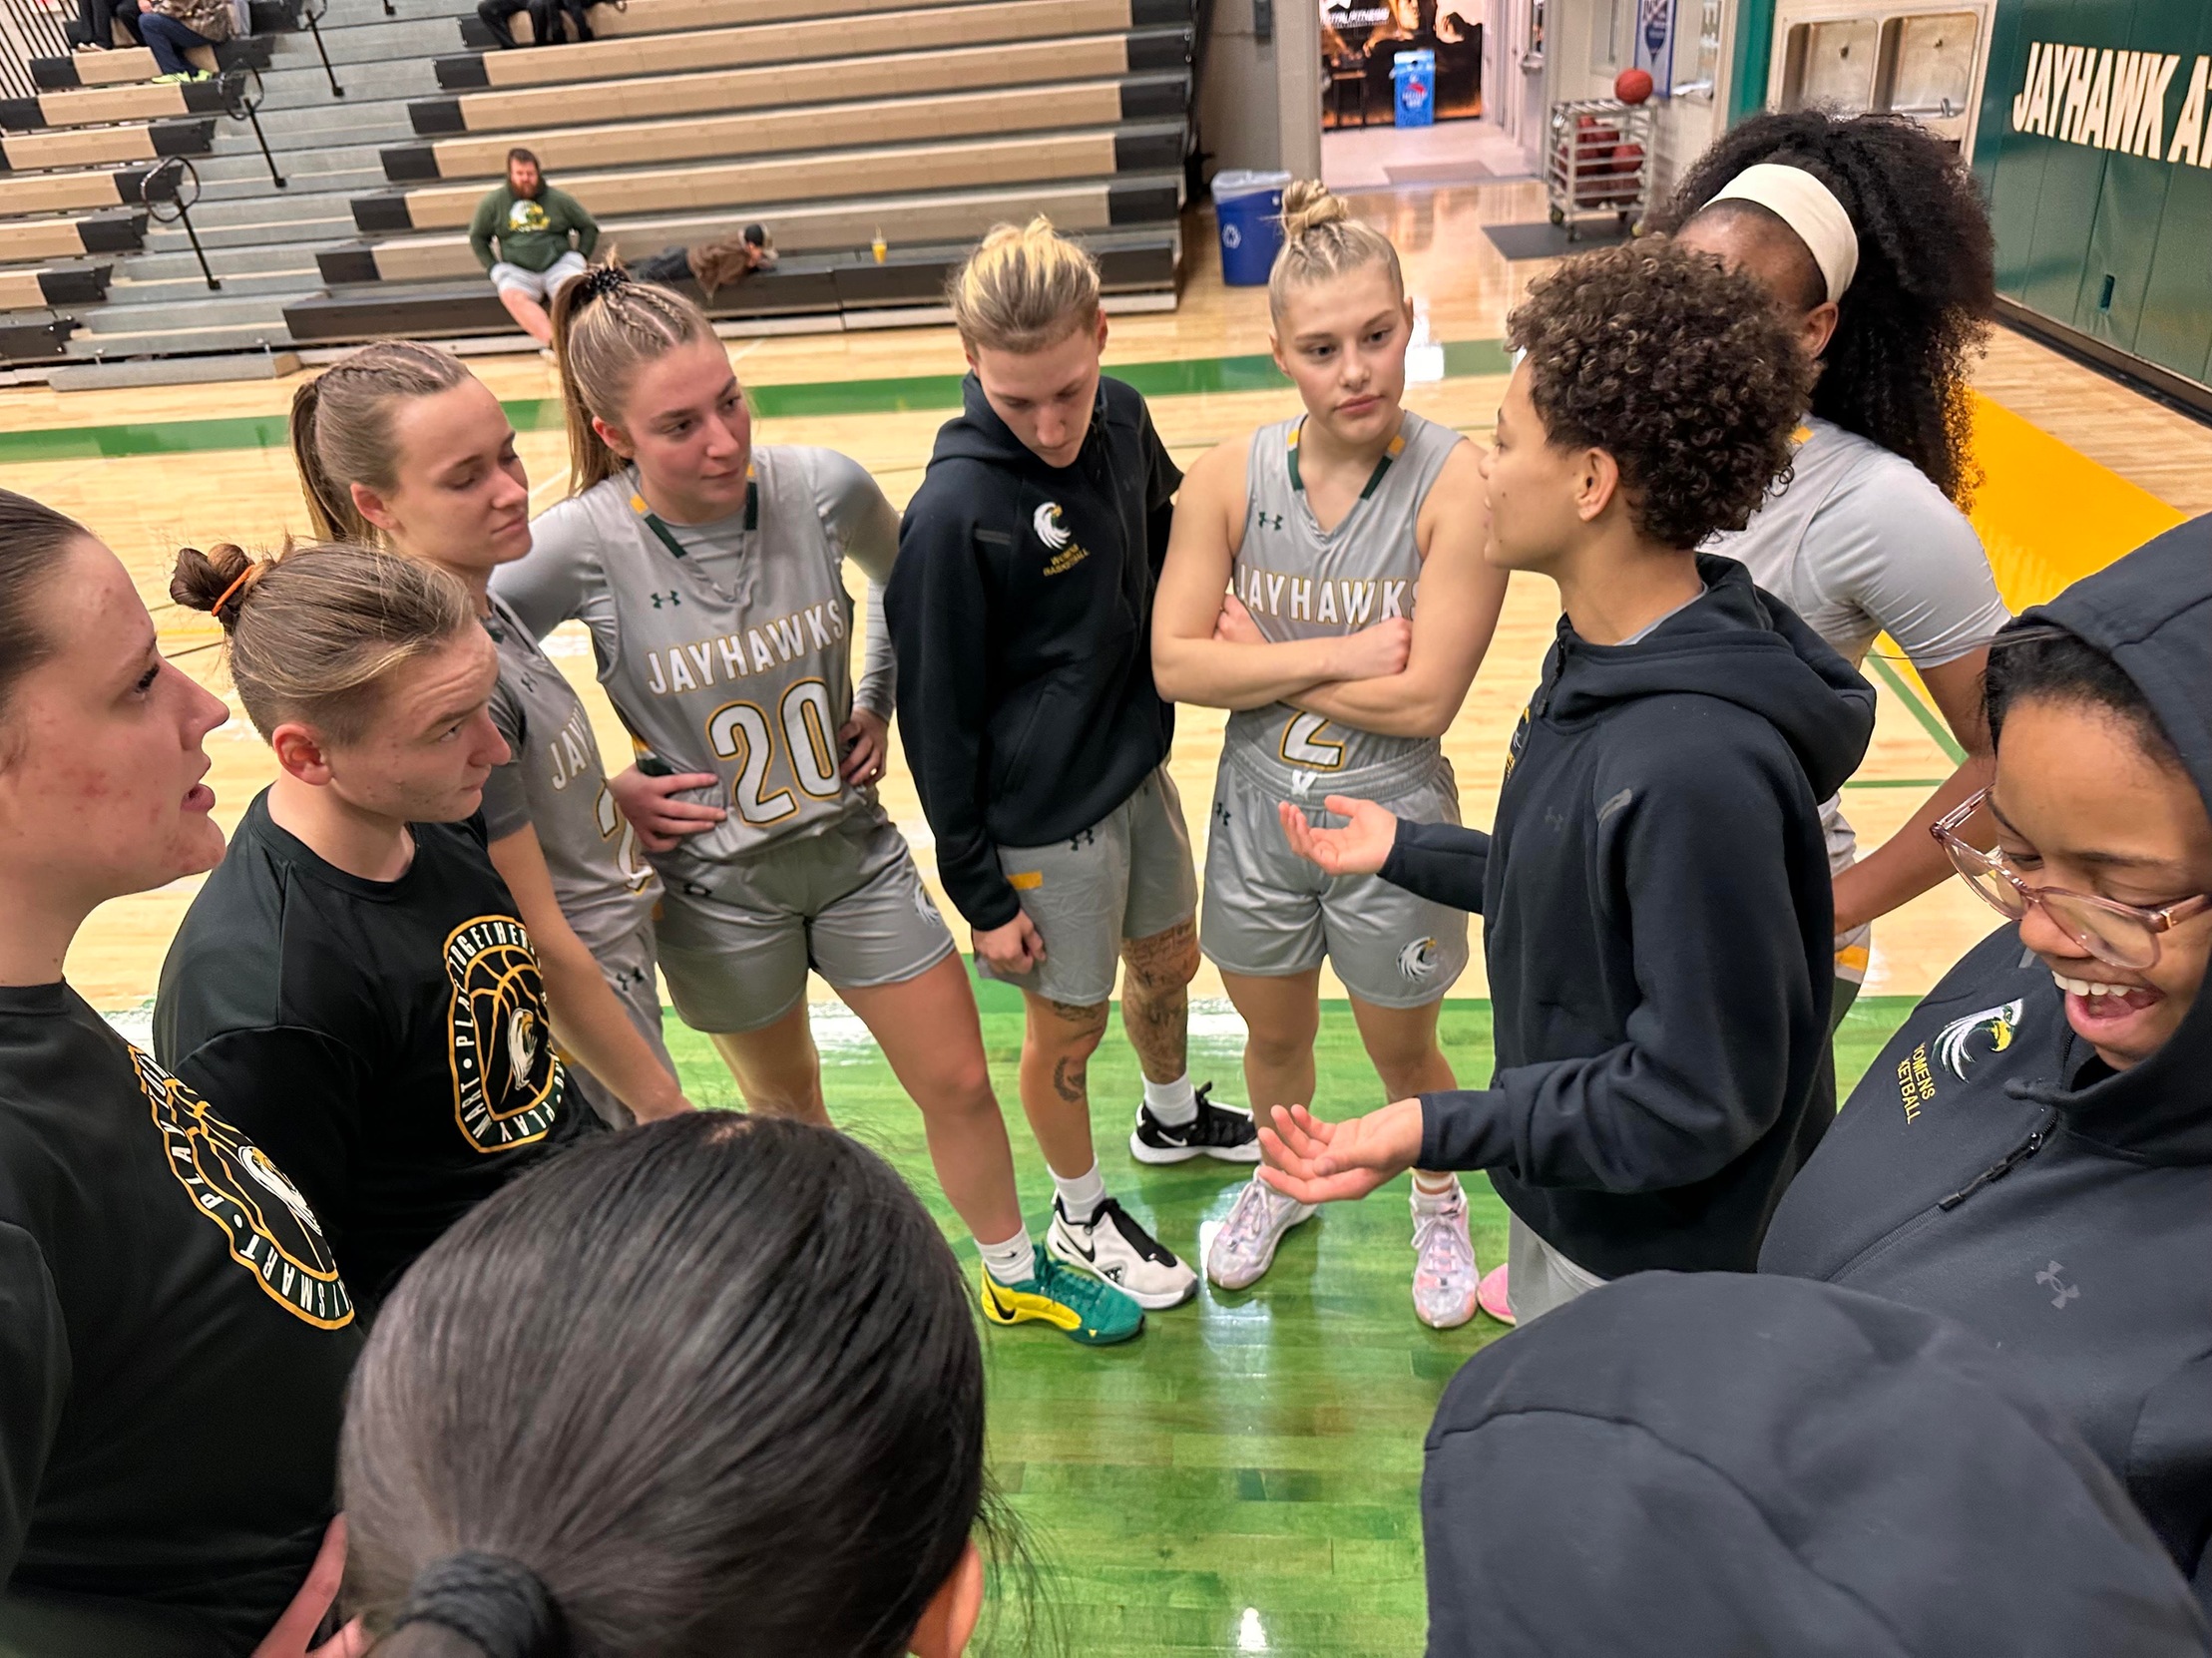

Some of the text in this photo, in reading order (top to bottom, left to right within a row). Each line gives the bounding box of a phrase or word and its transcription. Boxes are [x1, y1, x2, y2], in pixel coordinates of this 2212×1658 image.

[2011, 41, 2180, 161] JAYHAWK
[648, 599, 845, 695] JAYHAWKS
[706, 676, 842, 825] 20
